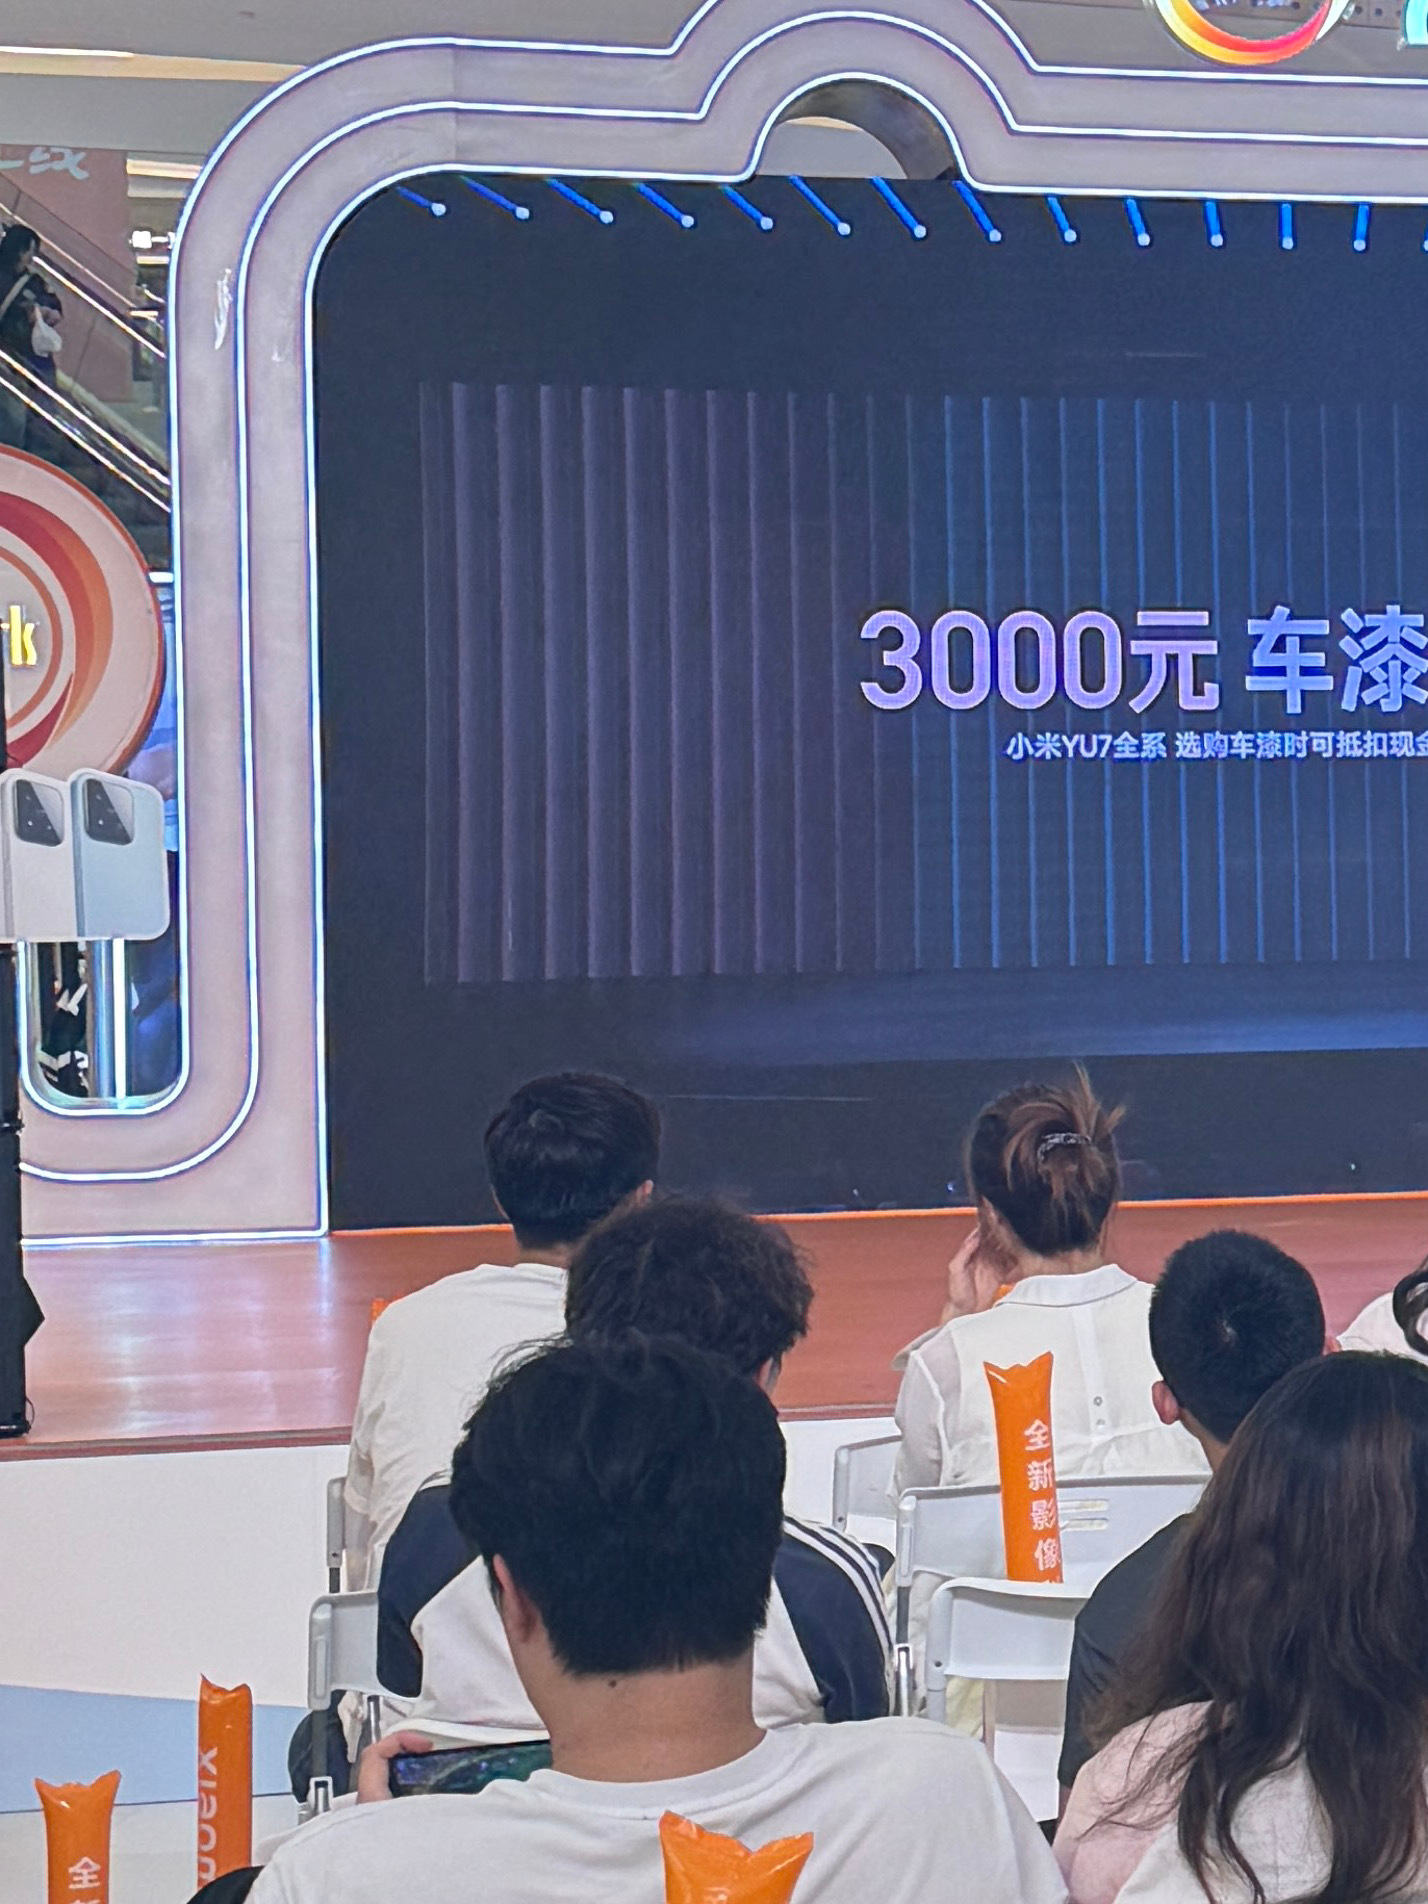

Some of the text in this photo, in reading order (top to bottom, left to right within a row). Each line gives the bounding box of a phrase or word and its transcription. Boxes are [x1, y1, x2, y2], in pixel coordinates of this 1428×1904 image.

[859, 607, 1220, 714] 3000元
[1005, 731, 1168, 760] 小米YU7全系
[1024, 1419, 1060, 1583] 全新影像
